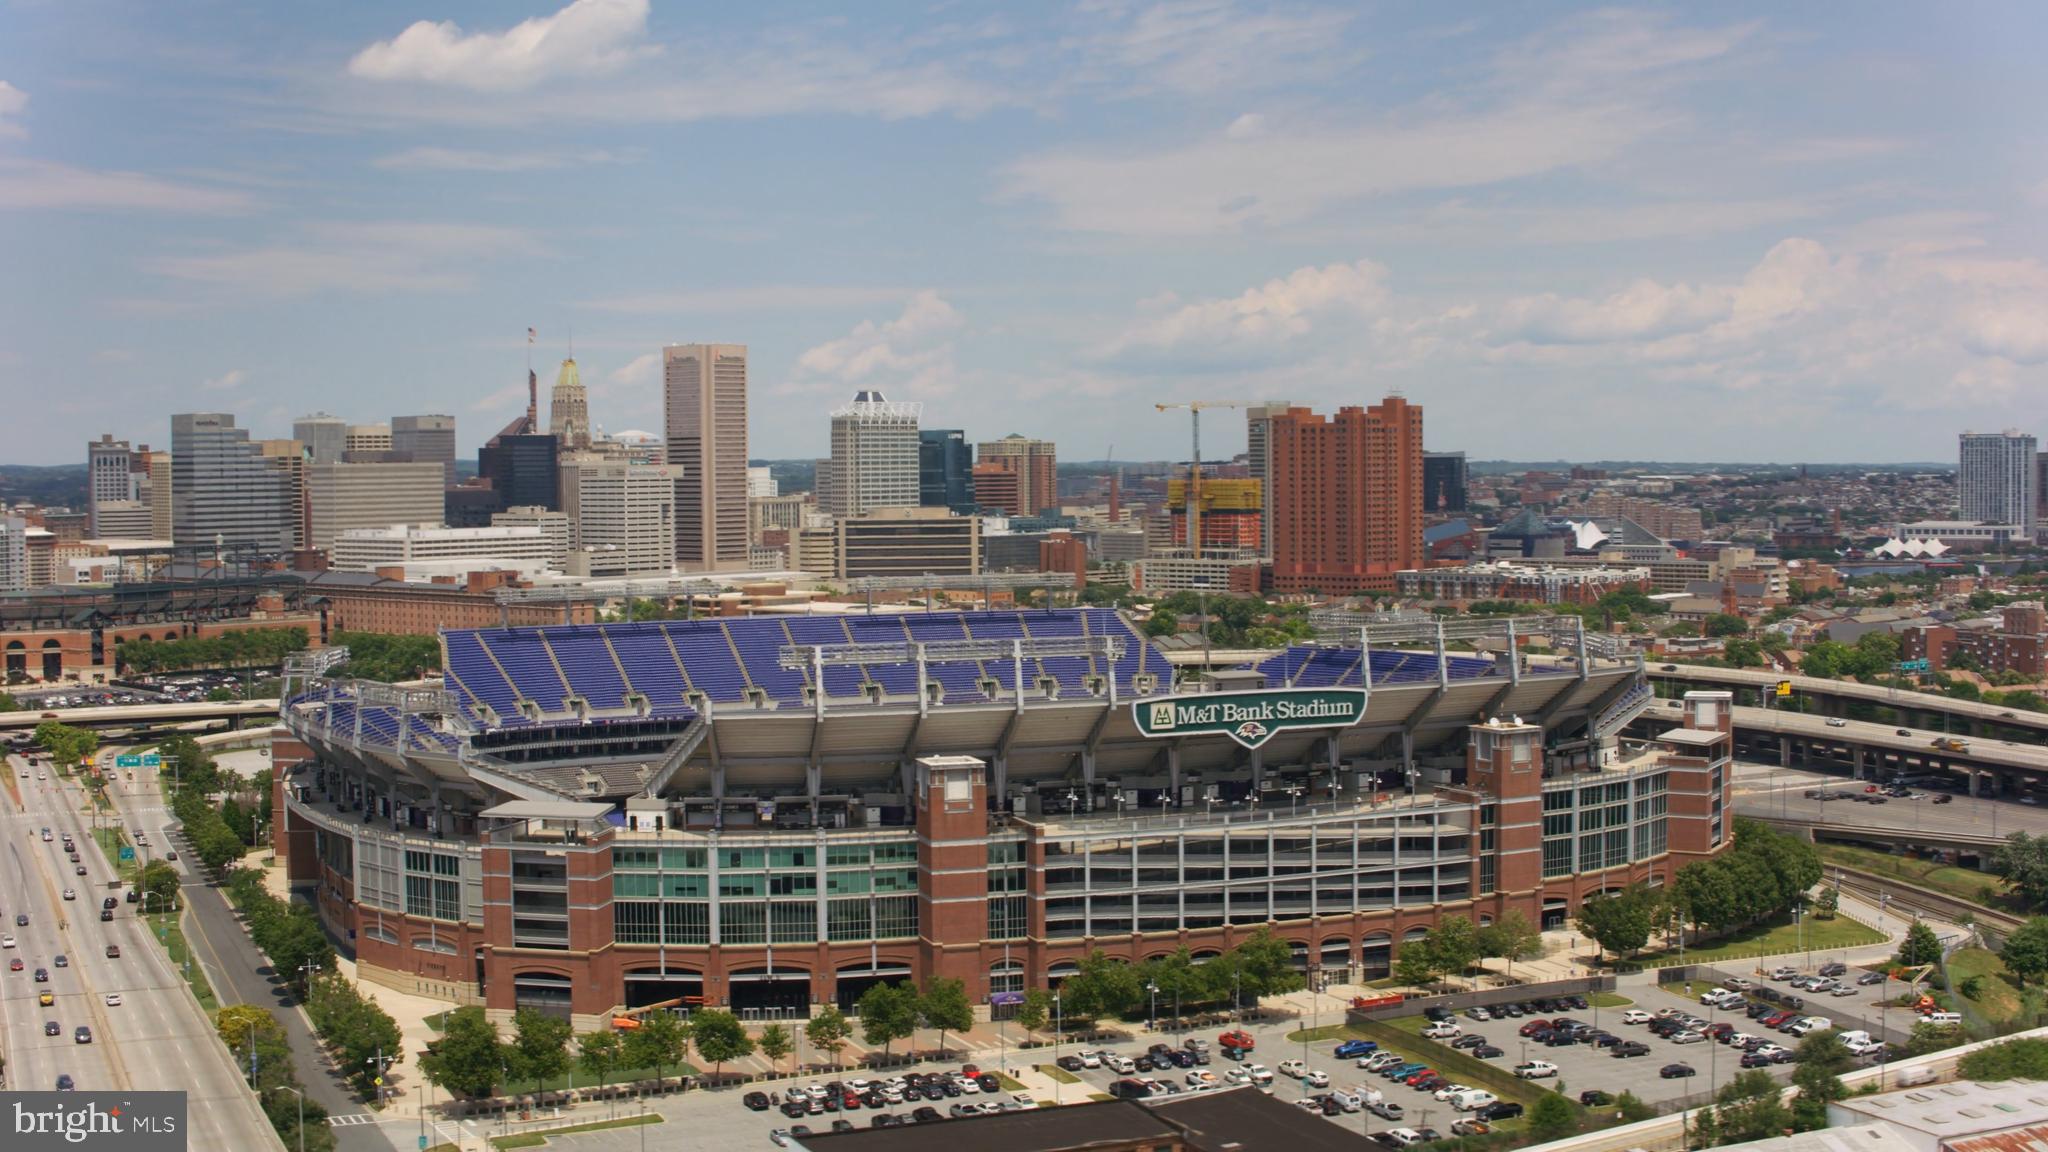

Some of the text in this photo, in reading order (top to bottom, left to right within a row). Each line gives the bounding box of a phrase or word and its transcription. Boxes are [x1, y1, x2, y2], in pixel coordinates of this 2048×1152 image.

[1177, 699, 1353, 725] M&T Bank Stadium
